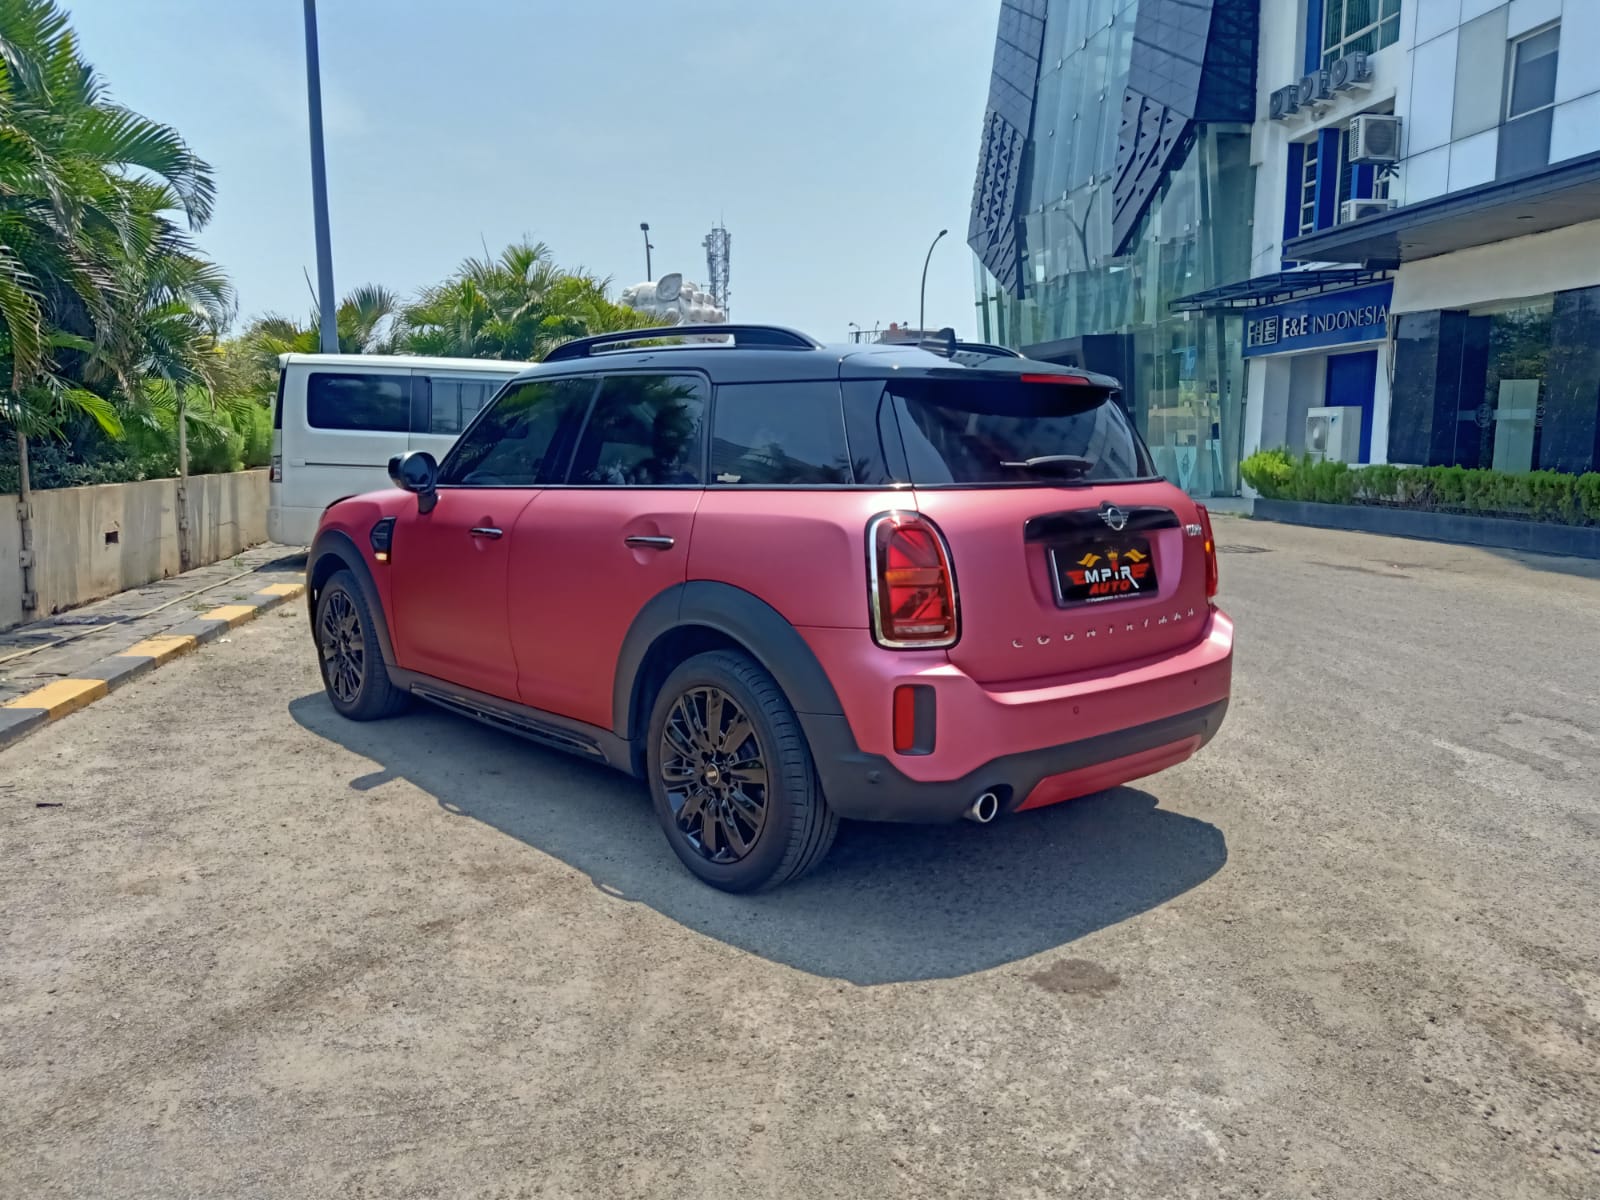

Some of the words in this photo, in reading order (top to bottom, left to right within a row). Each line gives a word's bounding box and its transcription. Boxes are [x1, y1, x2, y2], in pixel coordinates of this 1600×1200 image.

[1282, 315, 1308, 338] E&E
[1312, 305, 1387, 334] INDONESIA
[1089, 580, 1131, 595] AUTO
